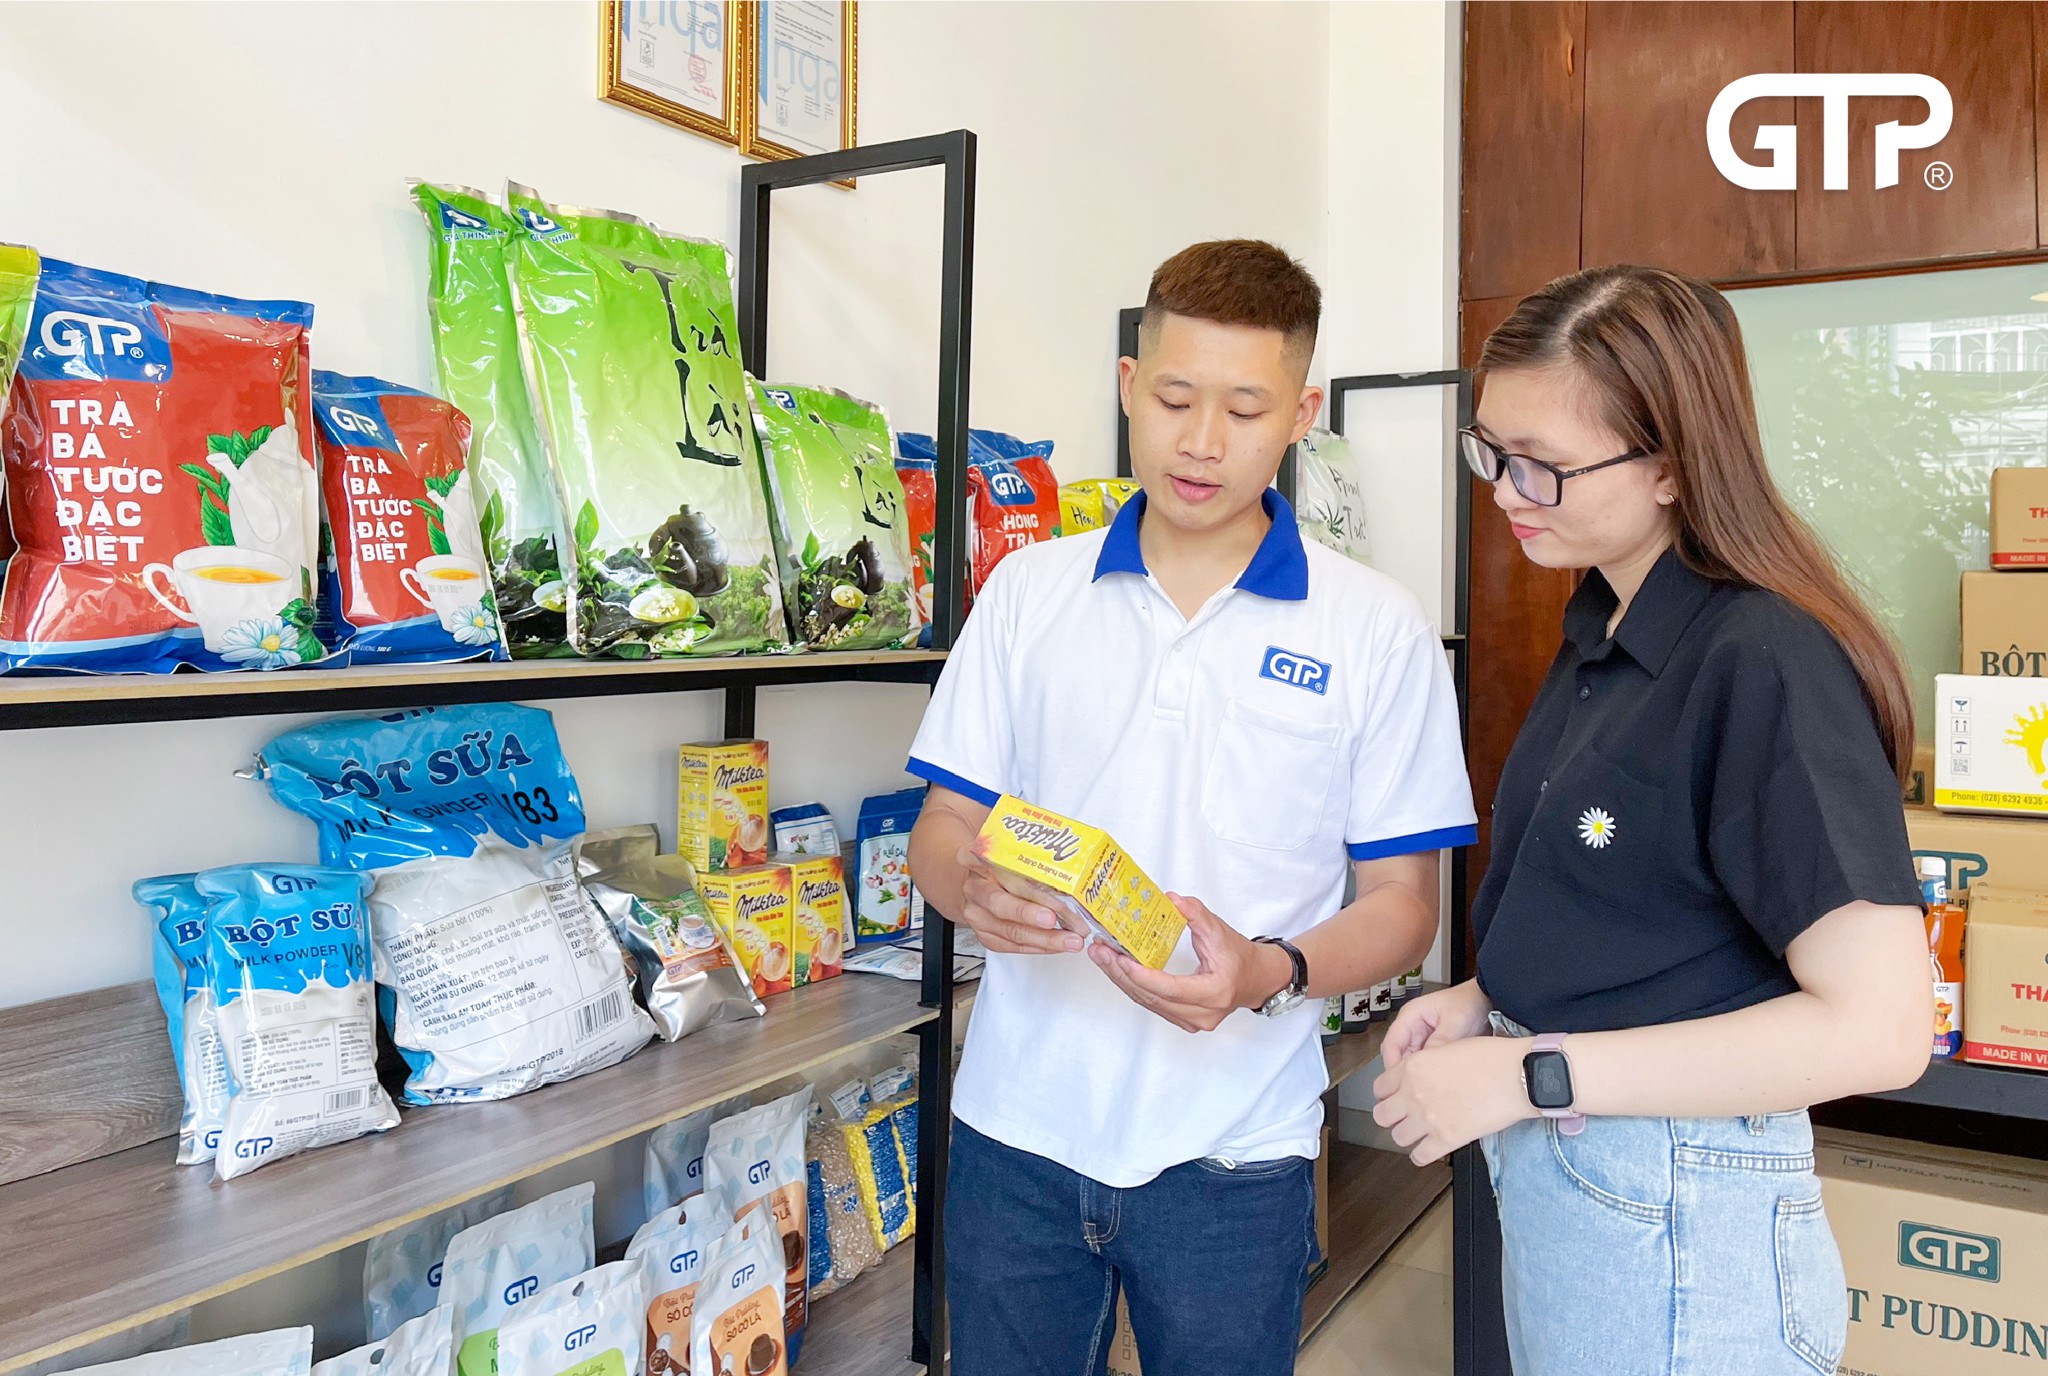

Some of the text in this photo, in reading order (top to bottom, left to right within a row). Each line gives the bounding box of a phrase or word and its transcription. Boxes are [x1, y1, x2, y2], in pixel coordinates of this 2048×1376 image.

[620, 260, 732, 359] Trà
[41, 311, 141, 356] GTP
[50, 392, 134, 426] TRÀ
[330, 406, 378, 437] GTP
[52, 424, 106, 459] BÁ
[54, 458, 163, 494] TƯỚC
[347, 453, 392, 474] TRÀ
[350, 473, 381, 495] BÁ
[991, 473, 1024, 496] GTP
[56, 496, 142, 530] ĐẶC
[353, 493, 412, 516] TƯỚC
[356, 517, 404, 541] ĐẶC
[62, 531, 144, 565] BIỆT
[360, 540, 407, 564] BIỆT
[1270, 652, 1323, 685] GTP
[427, 729, 532, 786] SỮA
[713, 763, 766, 790] Milktea
[412, 792, 491, 819] OWDER
[499, 786, 559, 826] V83
[1951, 792, 1979, 802] Phone:
[1002, 815, 1080, 862] Milktea
[1911, 849, 1989, 890] TP
[798, 879, 841, 905] Milktea
[735, 893, 788, 920] Milktea
[224, 914, 301, 947] BỘT
[274, 945, 339, 964] POWDER
[1982, 1047, 2017, 1061] MADE
[2020, 1049, 2032, 1063] IN
[235, 1136, 273, 1158] GTP
[748, 1160, 770, 1184] GTP
[670, 1250, 698, 1273] GTP
[1909, 1230, 1990, 1271] GTP
[732, 1264, 755, 1288] GTP
[504, 1275, 538, 1306] GTP
[564, 1324, 597, 1351] GTP
